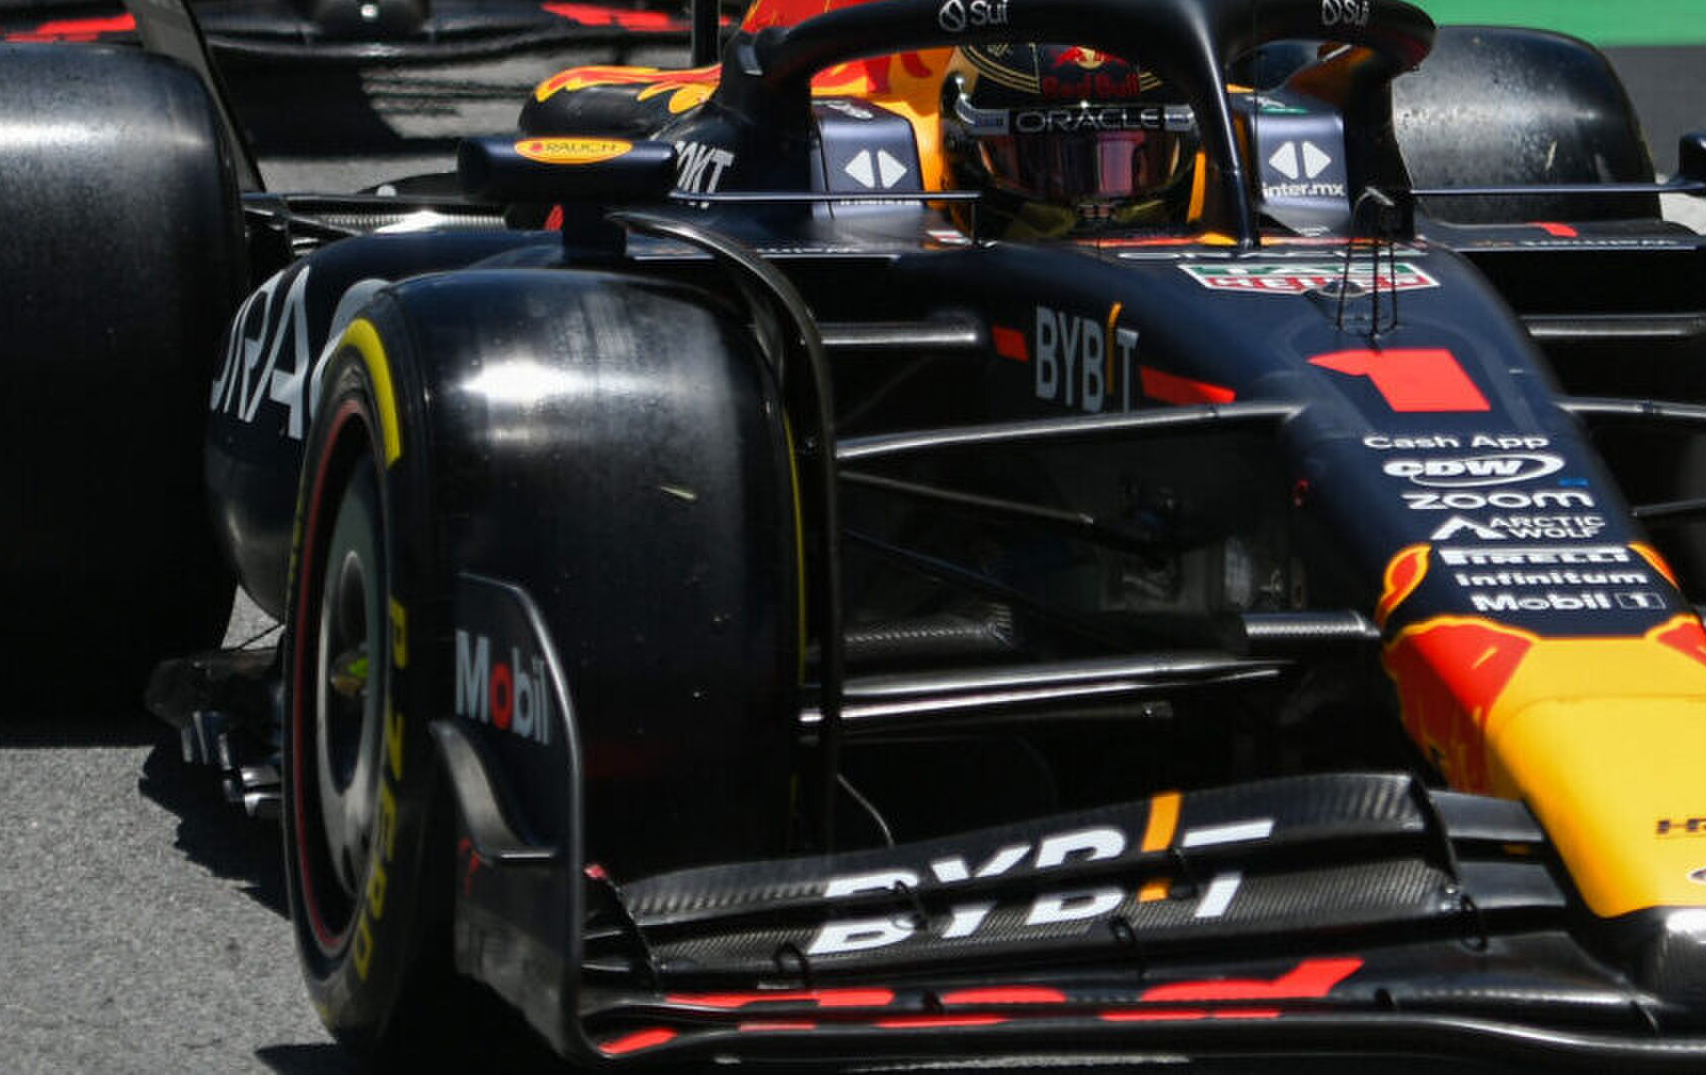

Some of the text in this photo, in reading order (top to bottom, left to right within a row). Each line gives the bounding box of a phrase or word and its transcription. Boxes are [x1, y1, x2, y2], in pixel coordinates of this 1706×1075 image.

[1016, 107, 1159, 133] ORACLE
[1262, 181, 1346, 199] inter.mx
[1035, 302, 1140, 414] BYBIT
[1307, 349, 1491, 413] 1
[1363, 435, 1550, 449] Cash App
[1402, 492, 1594, 509] zoom
[1488, 516, 1606, 527] ARCTIC
[1508, 526, 1601, 538] WOLF
[1439, 547, 1632, 565] PIRELLI
[1471, 592, 1612, 612] Mobil
[455, 629, 549, 745] Mobil
[807, 792, 1275, 954] BYBIT
